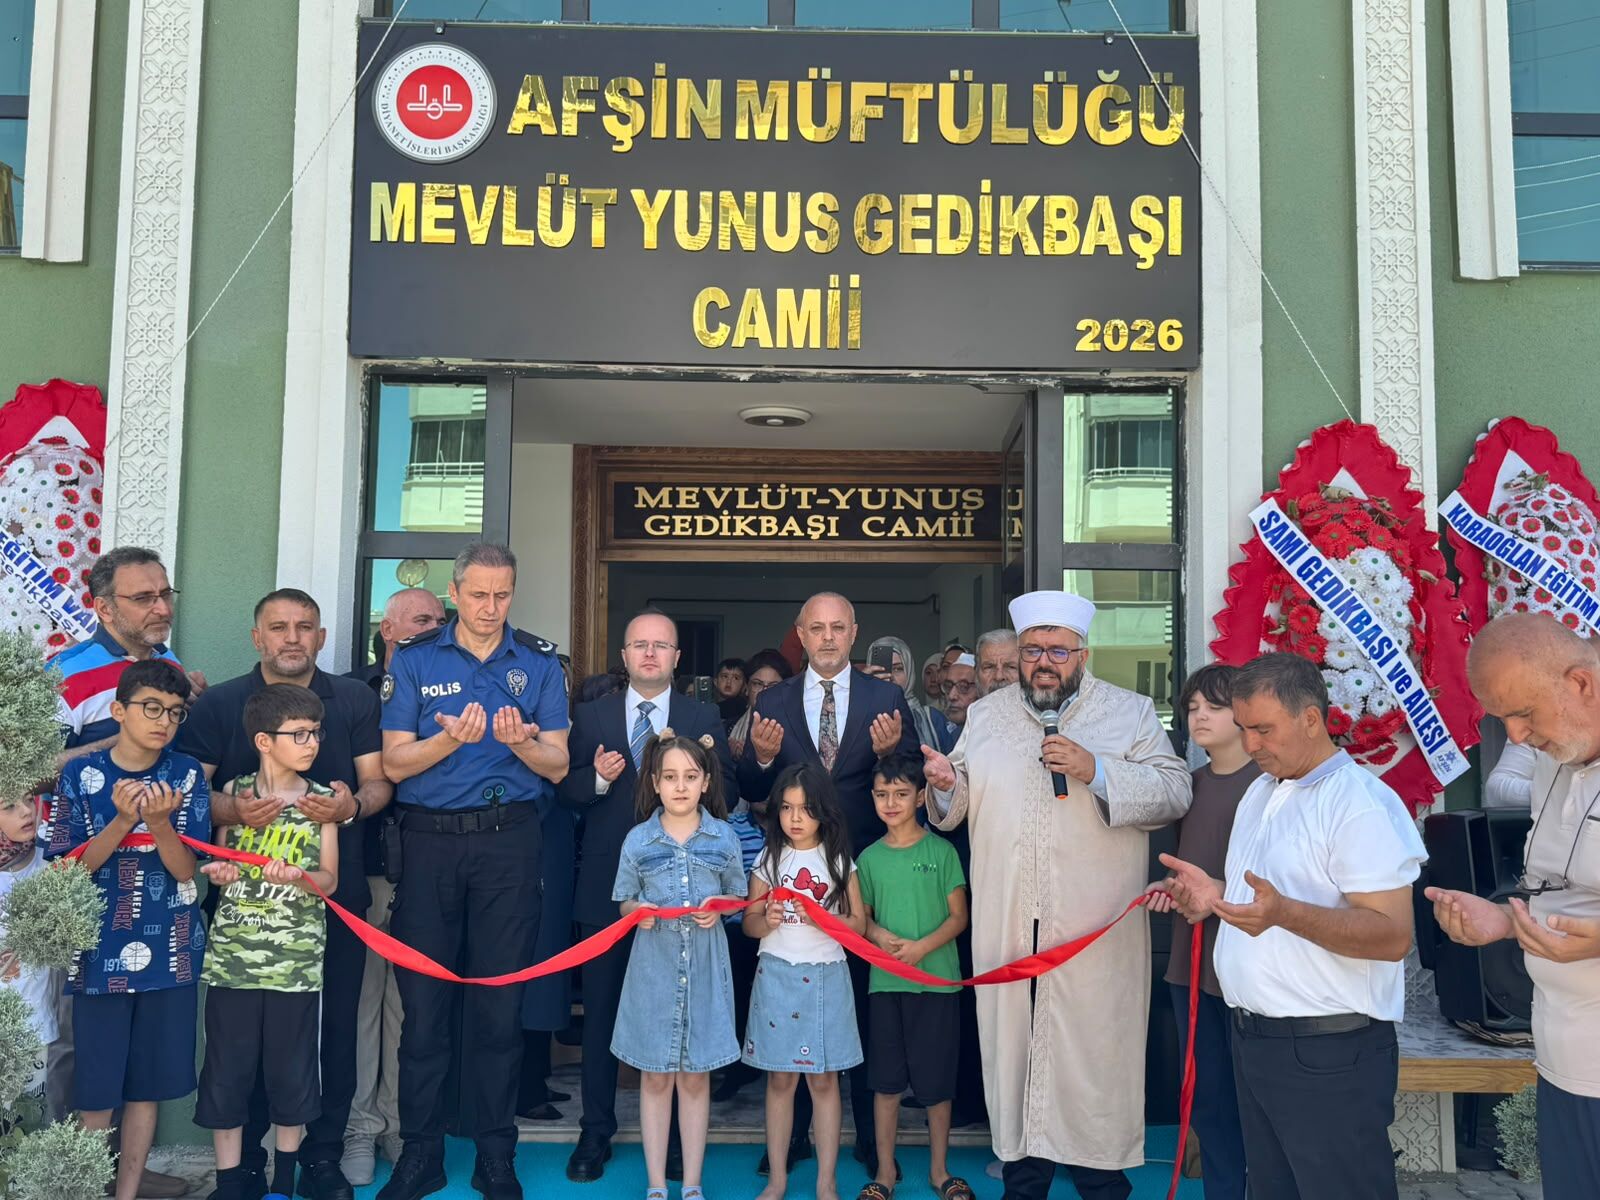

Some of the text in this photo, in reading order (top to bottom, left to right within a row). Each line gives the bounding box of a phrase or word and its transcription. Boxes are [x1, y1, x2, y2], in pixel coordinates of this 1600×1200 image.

[381, 102, 488, 155] DİYANET İŞLERİ BAŞKANLIĞI
[506, 63, 722, 153] AFŞİN
[735, 67, 1185, 147] MÜFTÜLÜĞÜ
[369, 172, 1183, 270] MEVLÜT YUNUS GEDİKBAŞI
[692, 274, 1185, 353] CAMİİ 2026
[633, 483, 985, 511] MEVLÜT-YUNUS
[644, 510, 840, 540] GEDİKBAŞI
[861, 510, 975, 538] CAMİİ
[1446, 502, 1599, 621] KARAOĞLAN EĞİTİM
[1259, 510, 1452, 756] SAMİ GEDİKBAŞI ve AİLESİ
[118, 857, 140, 890] NEW
[132, 870, 145, 919] RUN AHEAD
[112, 893, 133, 931] YORK
